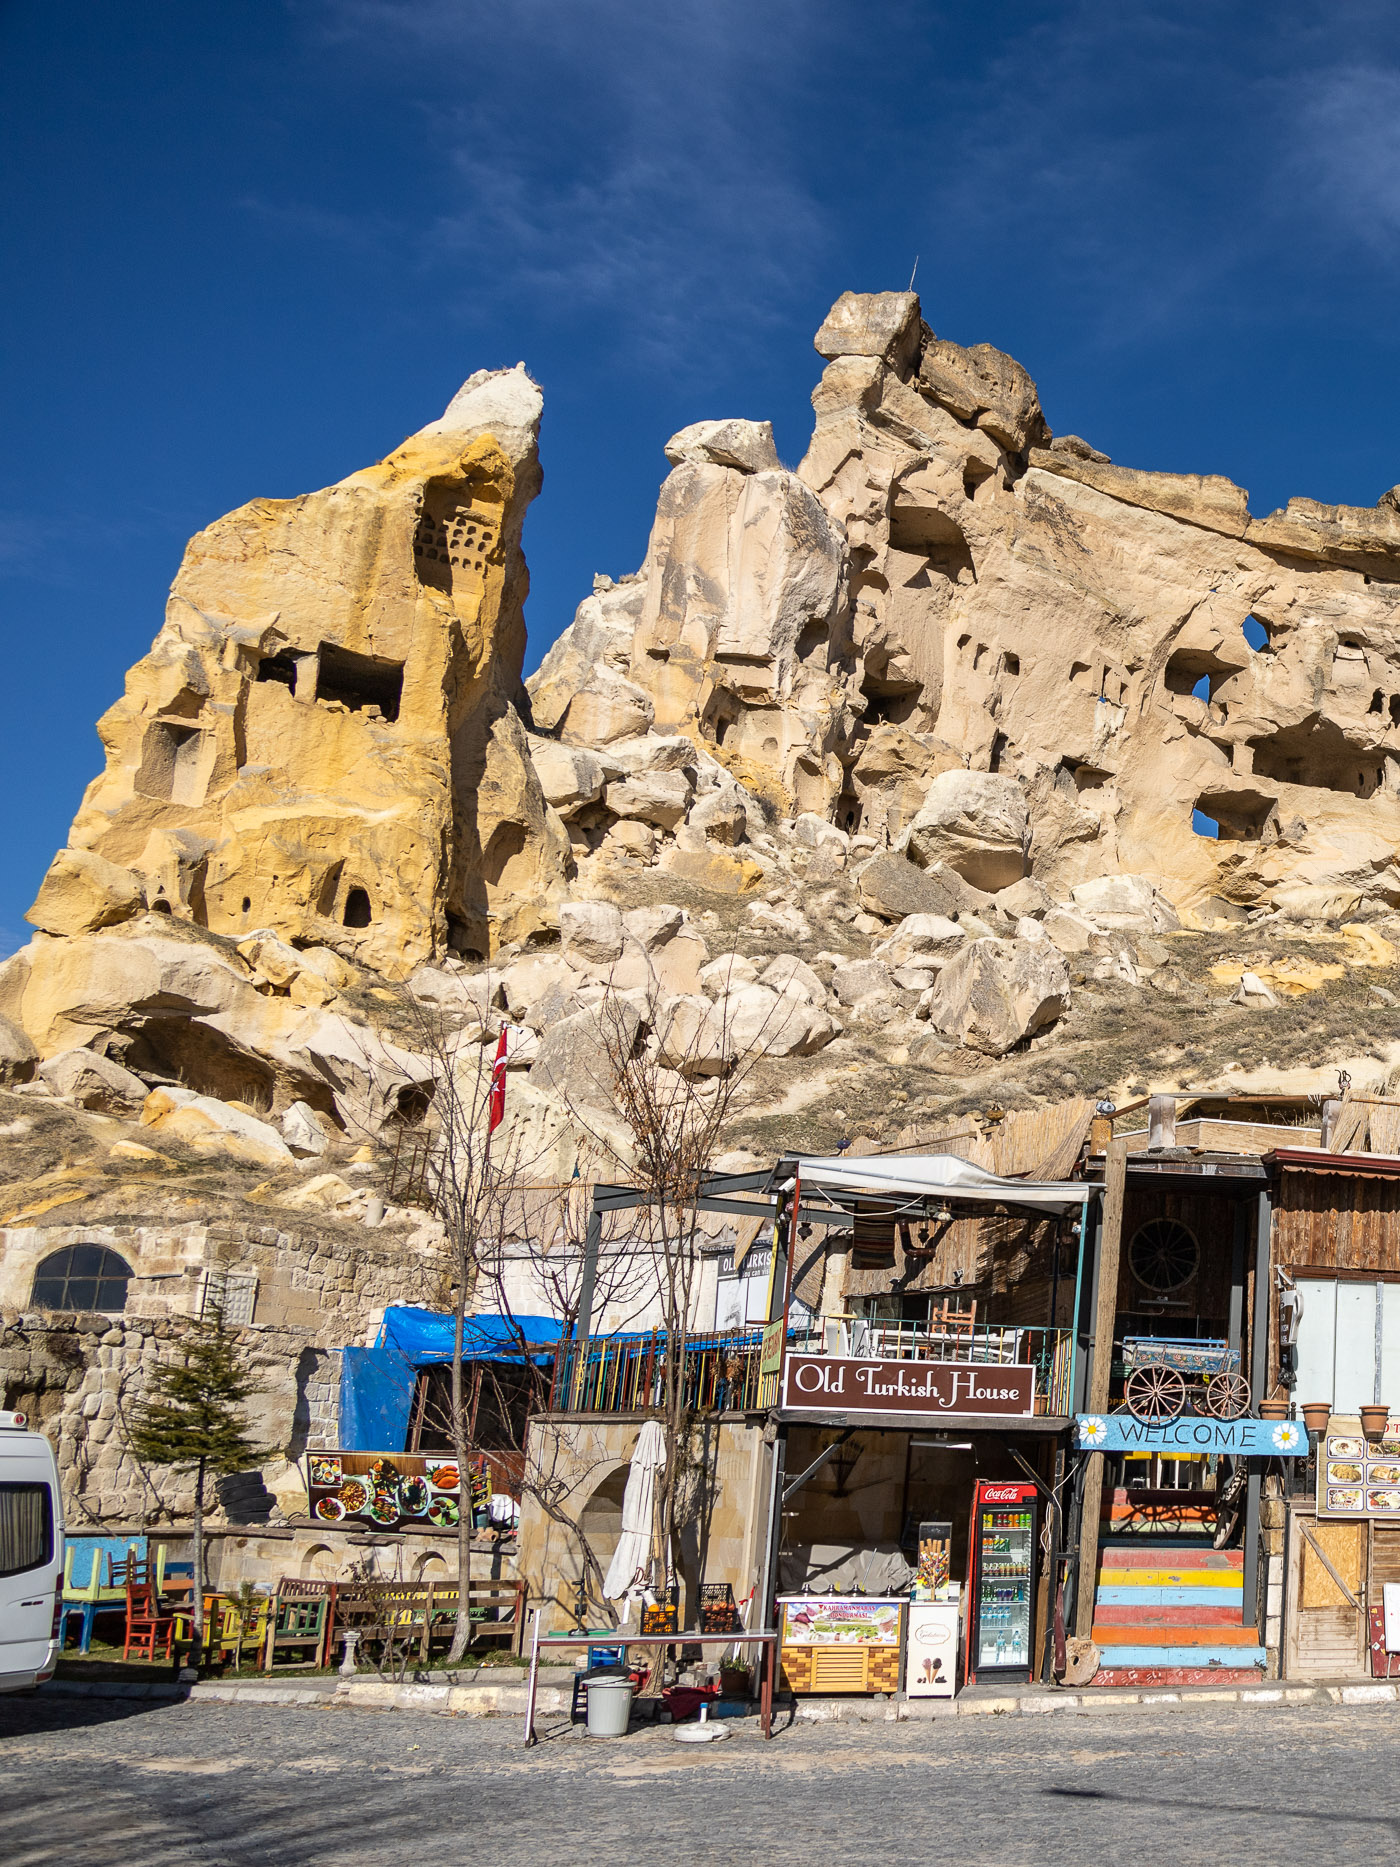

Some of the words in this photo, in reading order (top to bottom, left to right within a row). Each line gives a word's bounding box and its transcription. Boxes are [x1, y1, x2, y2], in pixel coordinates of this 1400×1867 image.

[795, 1364, 846, 1393] Old
[856, 1364, 940, 1398] Turkish
[938, 1371, 1020, 1408] House
[1118, 1422, 1257, 1448] WELCOME
[984, 1487, 1019, 1500] Coca-Cola
